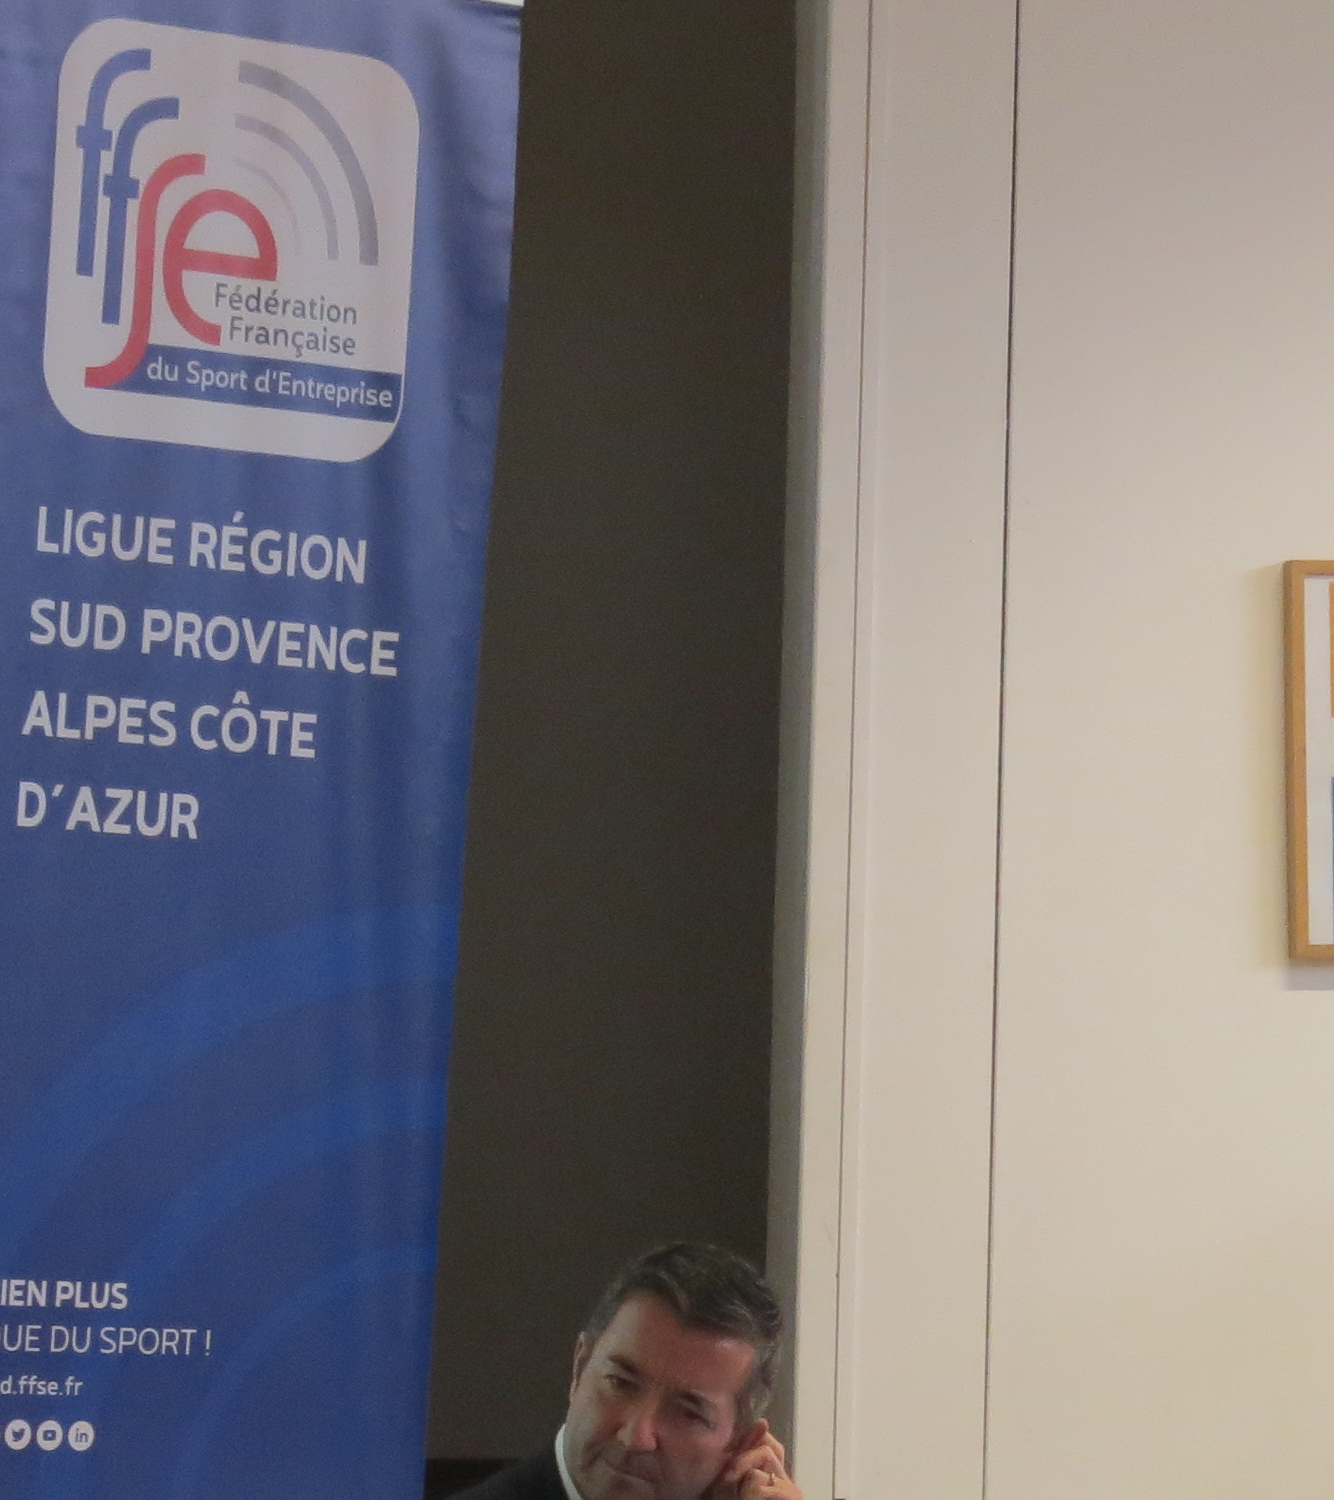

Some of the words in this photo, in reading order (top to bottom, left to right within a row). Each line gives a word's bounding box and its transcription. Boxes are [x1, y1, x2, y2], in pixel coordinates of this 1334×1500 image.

[214, 282, 358, 326] Fédération
[229, 316, 357, 358] Française
[147, 355, 179, 382] du
[186, 360, 248, 392] Sport
[254, 369, 393, 408] d'Entreprise
[36, 506, 175, 565] LIGUE
[189, 512, 367, 584] RÉGION
[29, 599, 126, 651] SUD
[141, 609, 400, 677] PROVENCE
[21, 690, 176, 747] ALPES
[190, 691, 318, 759] CÔTE
[55, 1281, 128, 1309] PLUS
[50, 1325, 91, 1354] DU
[100, 1327, 197, 1356] SPORT
